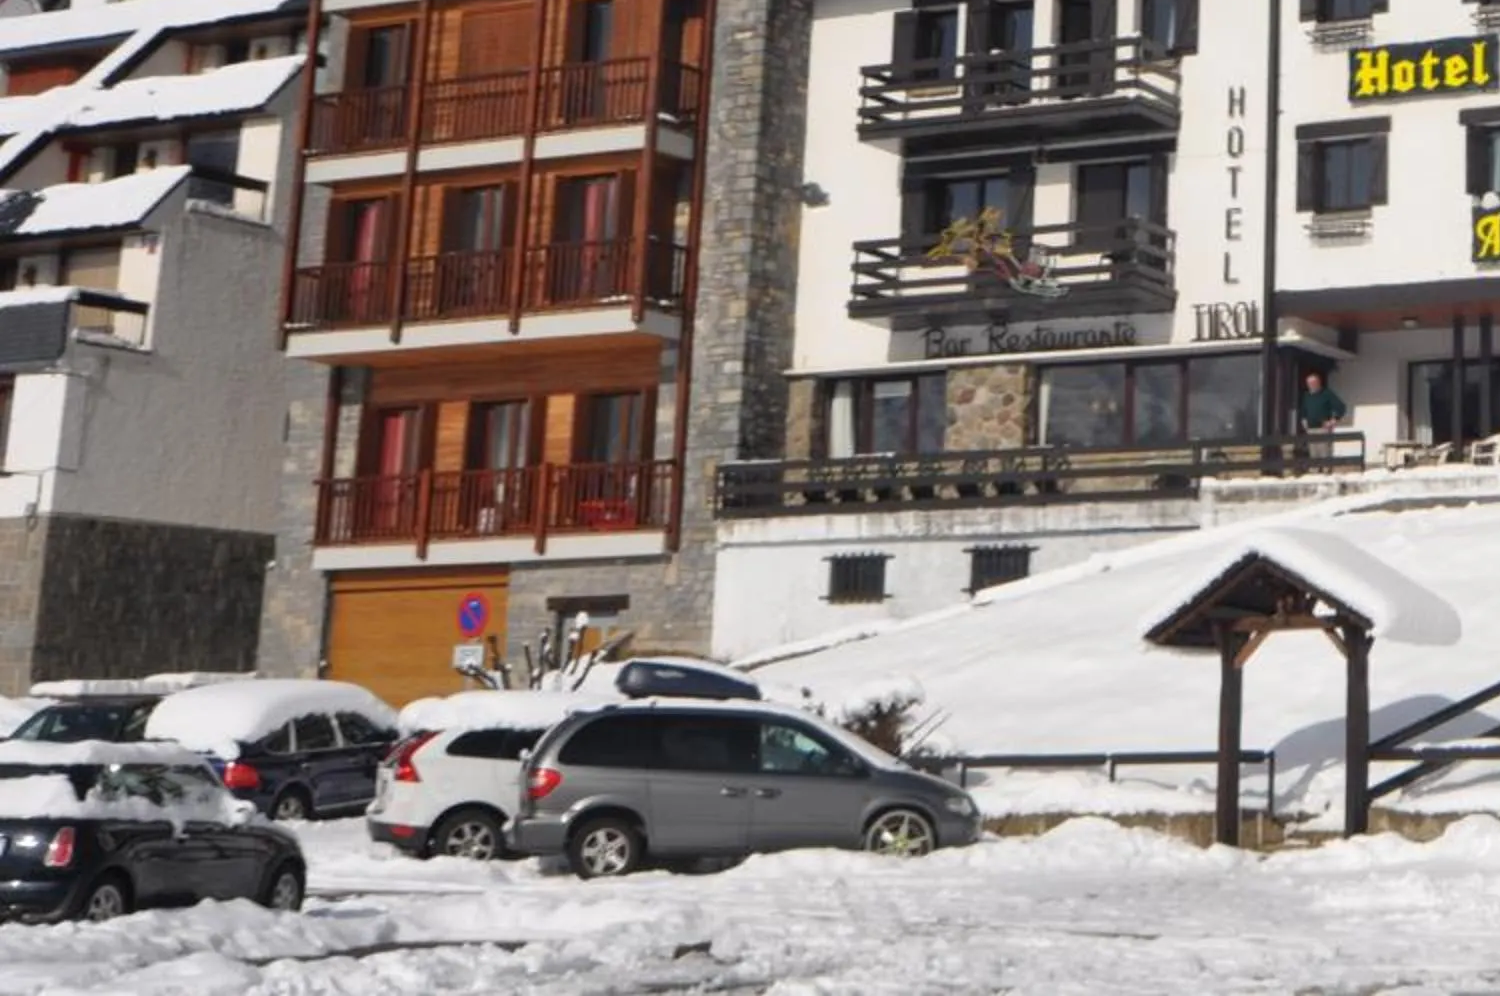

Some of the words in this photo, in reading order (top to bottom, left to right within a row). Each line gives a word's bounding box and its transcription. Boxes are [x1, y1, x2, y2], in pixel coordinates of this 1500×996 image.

[1355, 40, 1490, 98] Hotel
[1222, 85, 1246, 286] HOTEL
[921, 325, 972, 358] Bar
[984, 321, 1138, 354] Restaurante
[1192, 300, 1264, 343] TIROL
